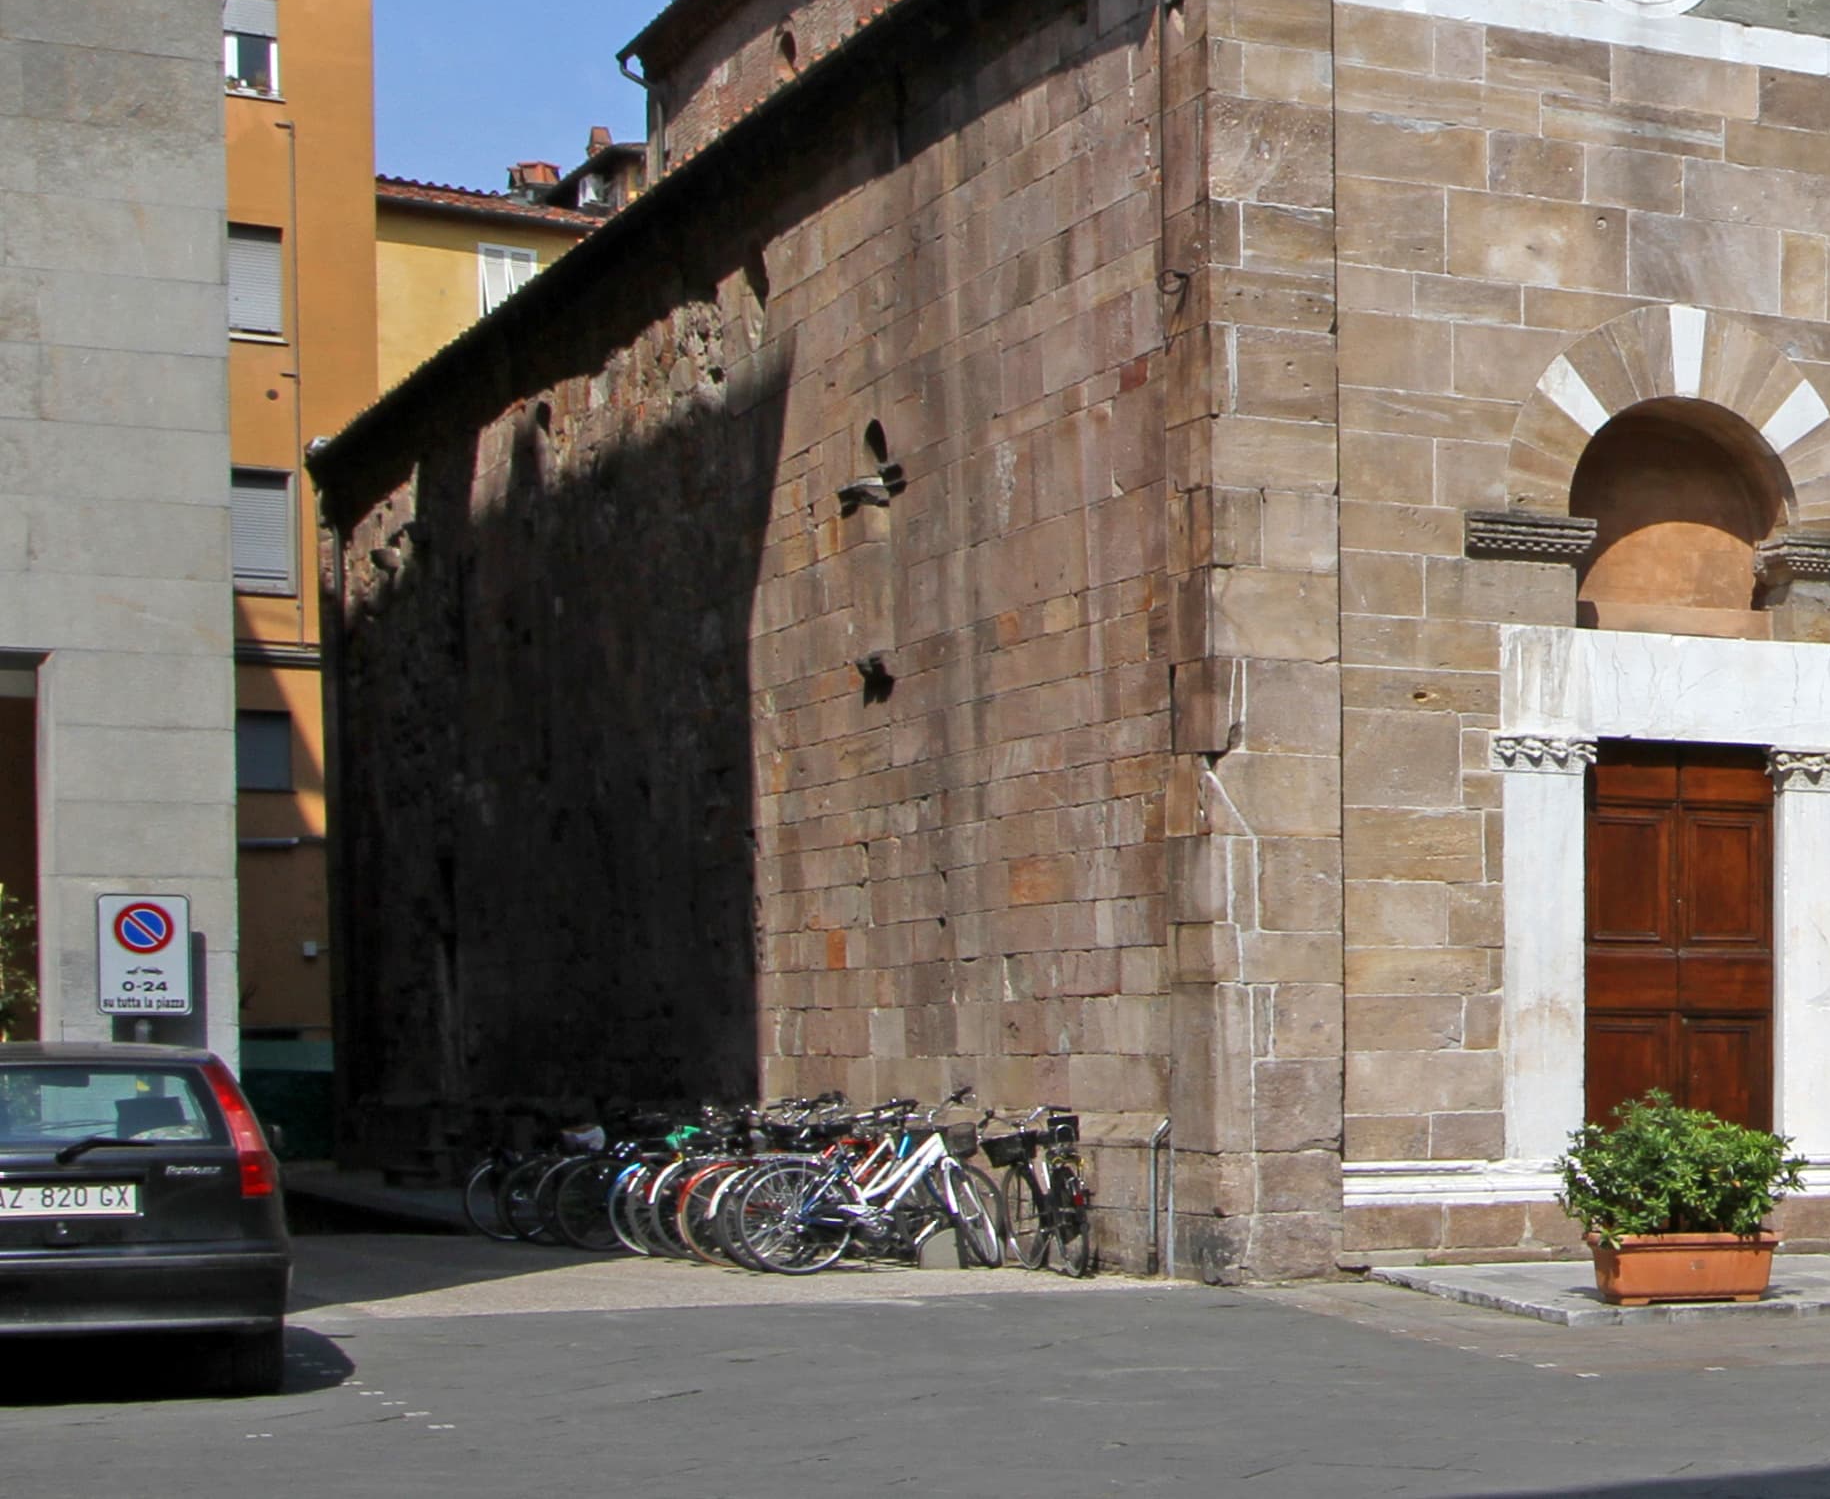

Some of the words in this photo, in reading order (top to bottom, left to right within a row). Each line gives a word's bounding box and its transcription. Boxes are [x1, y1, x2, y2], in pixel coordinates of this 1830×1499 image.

[122, 981, 168, 992] 0-24
[103, 999, 115, 1008] su
[117, 997, 141, 1008] tutta
[144, 997, 153, 1008] la
[156, 997, 185, 1010] piazza
[41, 1186, 88, 1208] 820
[100, 1185, 129, 1207] GX
